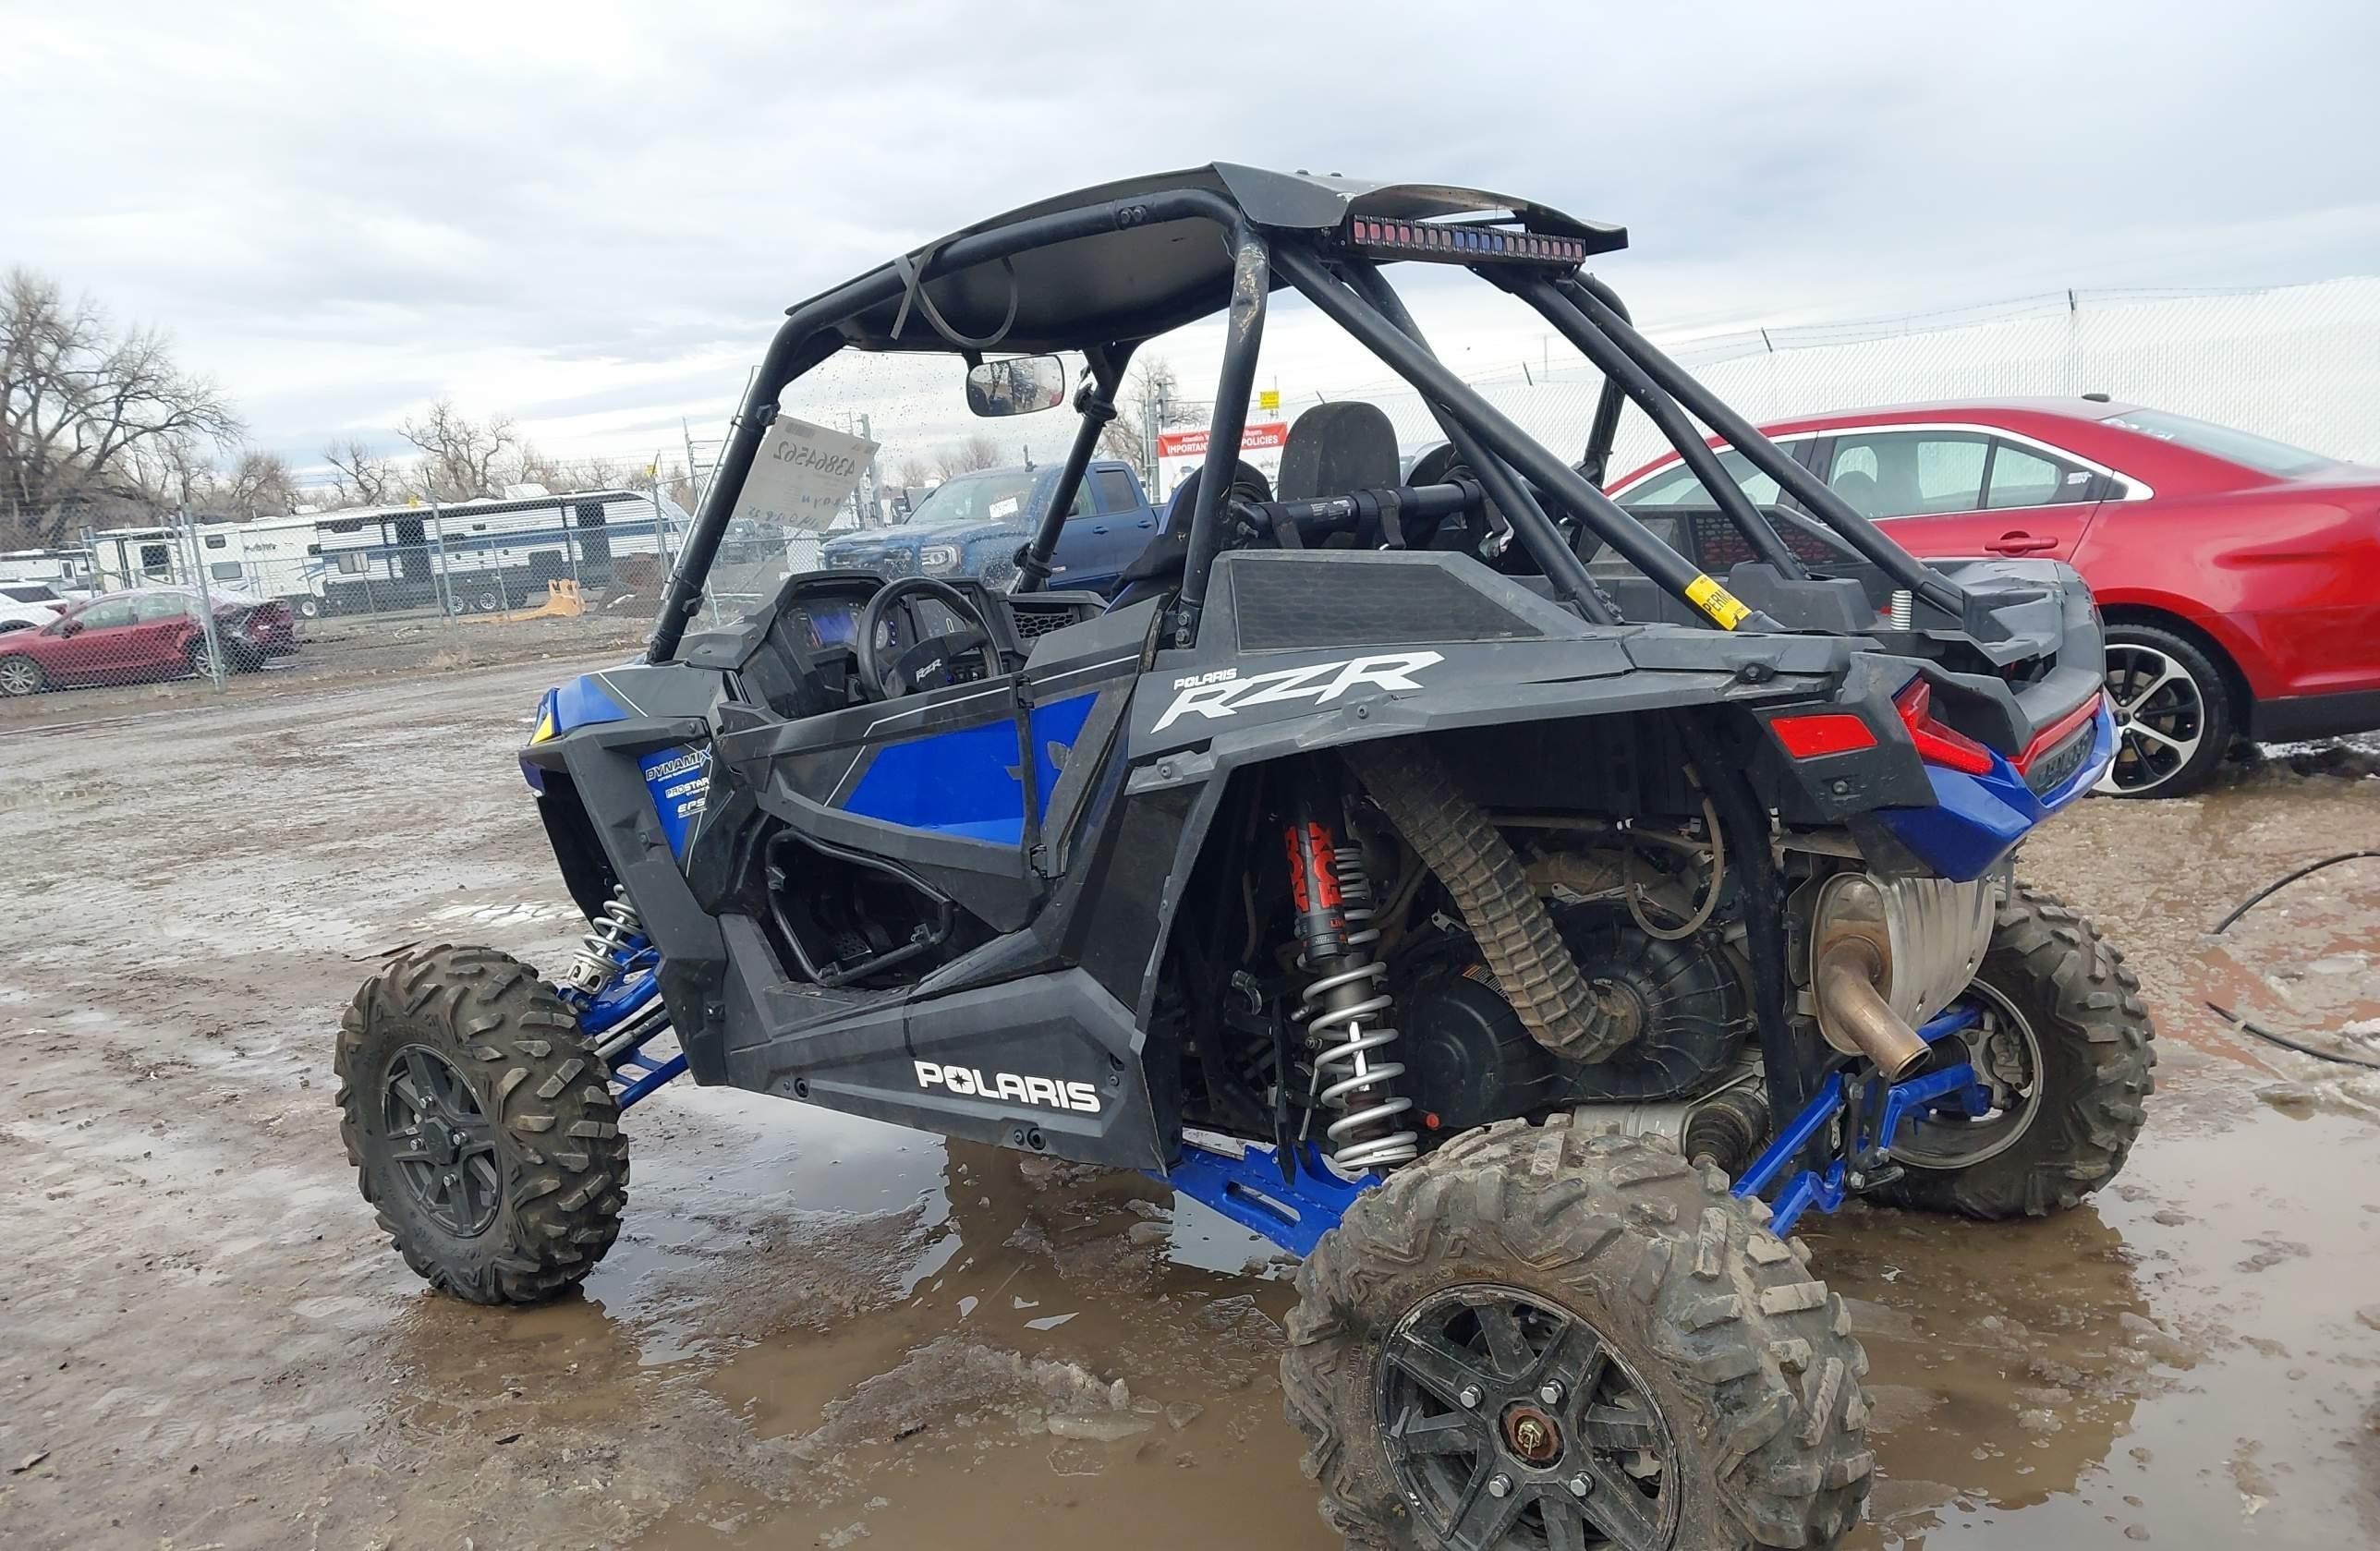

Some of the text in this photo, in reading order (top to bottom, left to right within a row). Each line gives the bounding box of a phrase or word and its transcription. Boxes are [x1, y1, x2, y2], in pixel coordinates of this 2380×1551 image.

[1241, 434, 1279, 446] POLICIES
[916, 658, 942, 684] RZR
[1173, 668, 1237, 690] POLARIS
[1149, 650, 1446, 735] RZR
[645, 742, 713, 782] DYNAMIX
[665, 777, 710, 798] PROSTAR
[677, 797, 706, 813] EPS
[914, 1060, 1101, 1113] POLARIS
